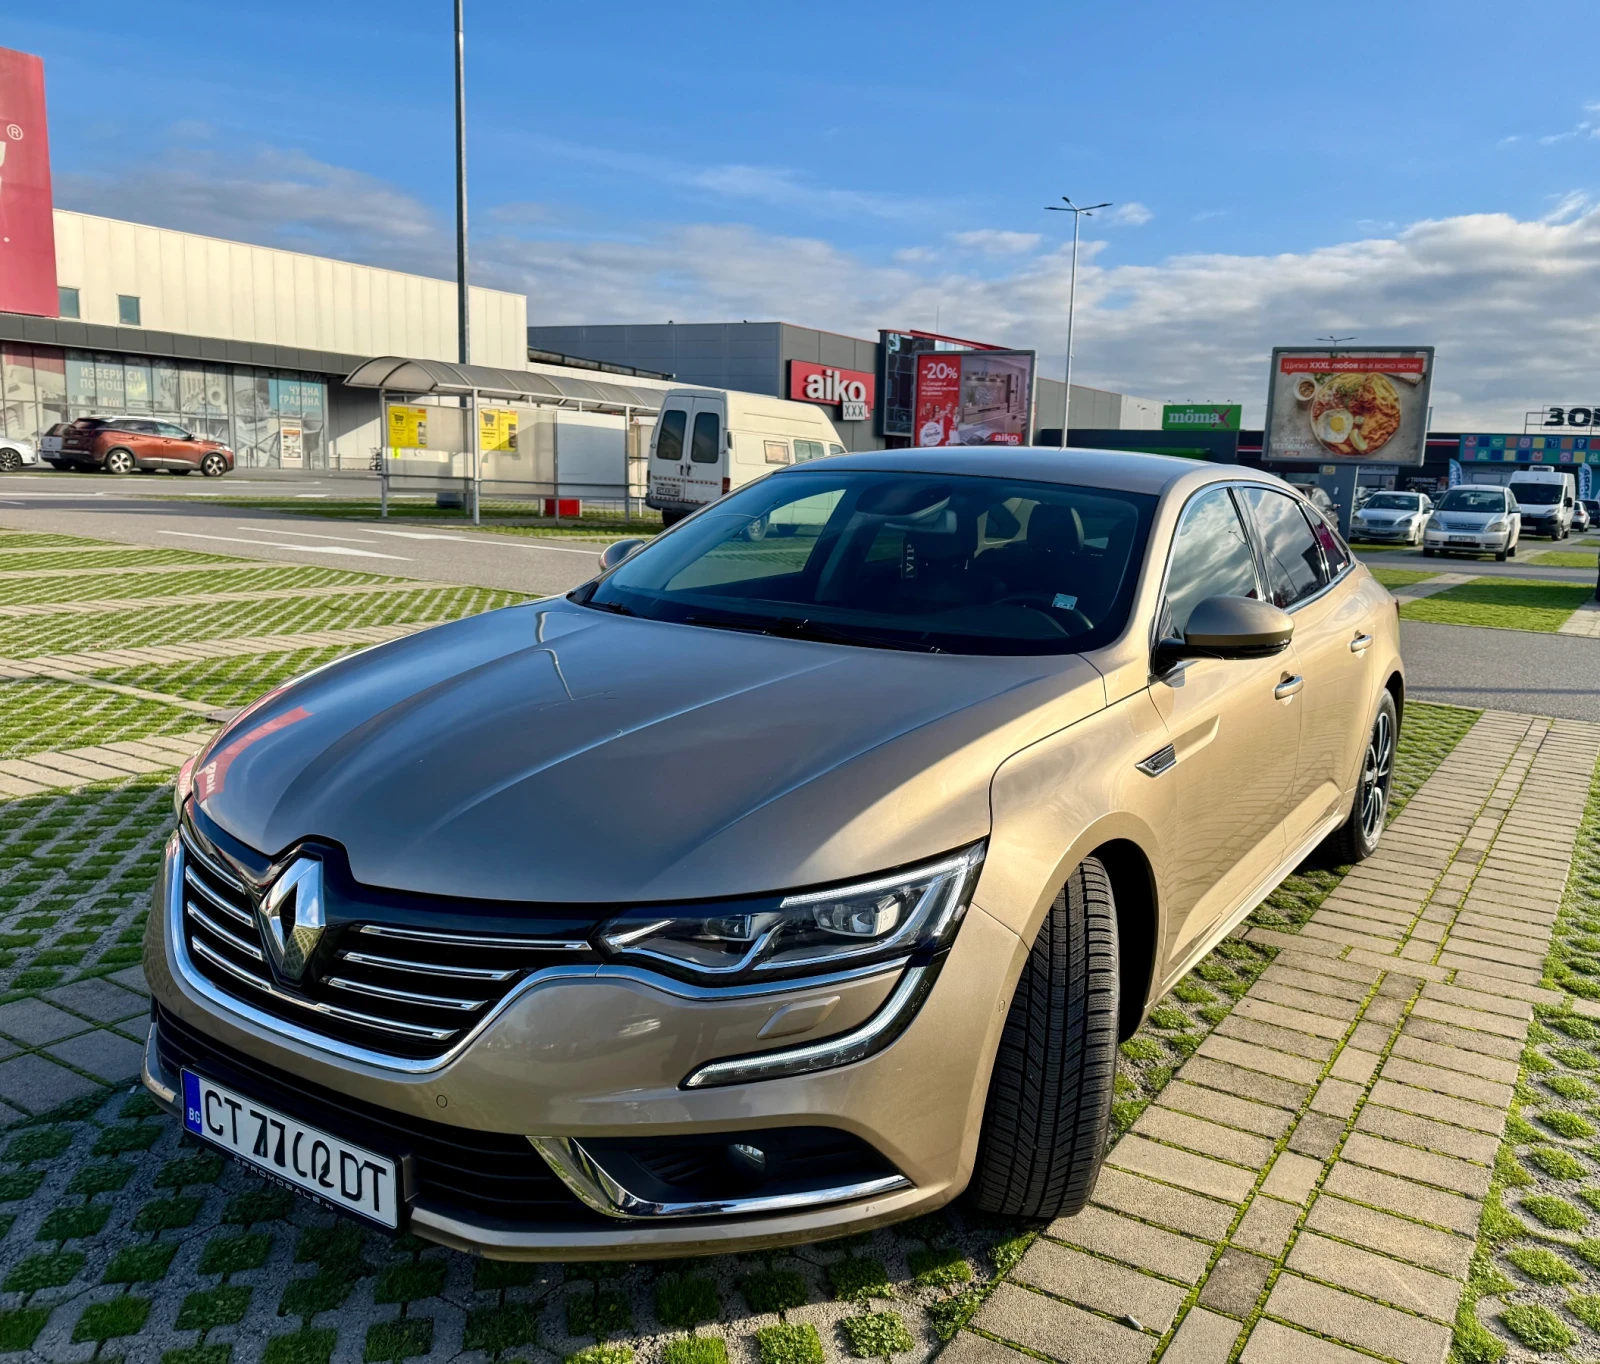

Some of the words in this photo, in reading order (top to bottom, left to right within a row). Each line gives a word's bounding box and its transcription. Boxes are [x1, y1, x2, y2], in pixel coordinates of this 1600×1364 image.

[1332, 361, 1359, 369] любов
[80, 366, 123, 380] ИЗБЕРИ
[127, 370, 141, 382] СИ
[289, 385, 319, 397] ЧУДНА
[806, 369, 867, 402] aiko
[279, 394, 320, 406] ГРАДИНА
[994, 433, 1019, 442] aiko
[906, 543, 915, 572] VIP
[188, 1107, 201, 1124] BG
